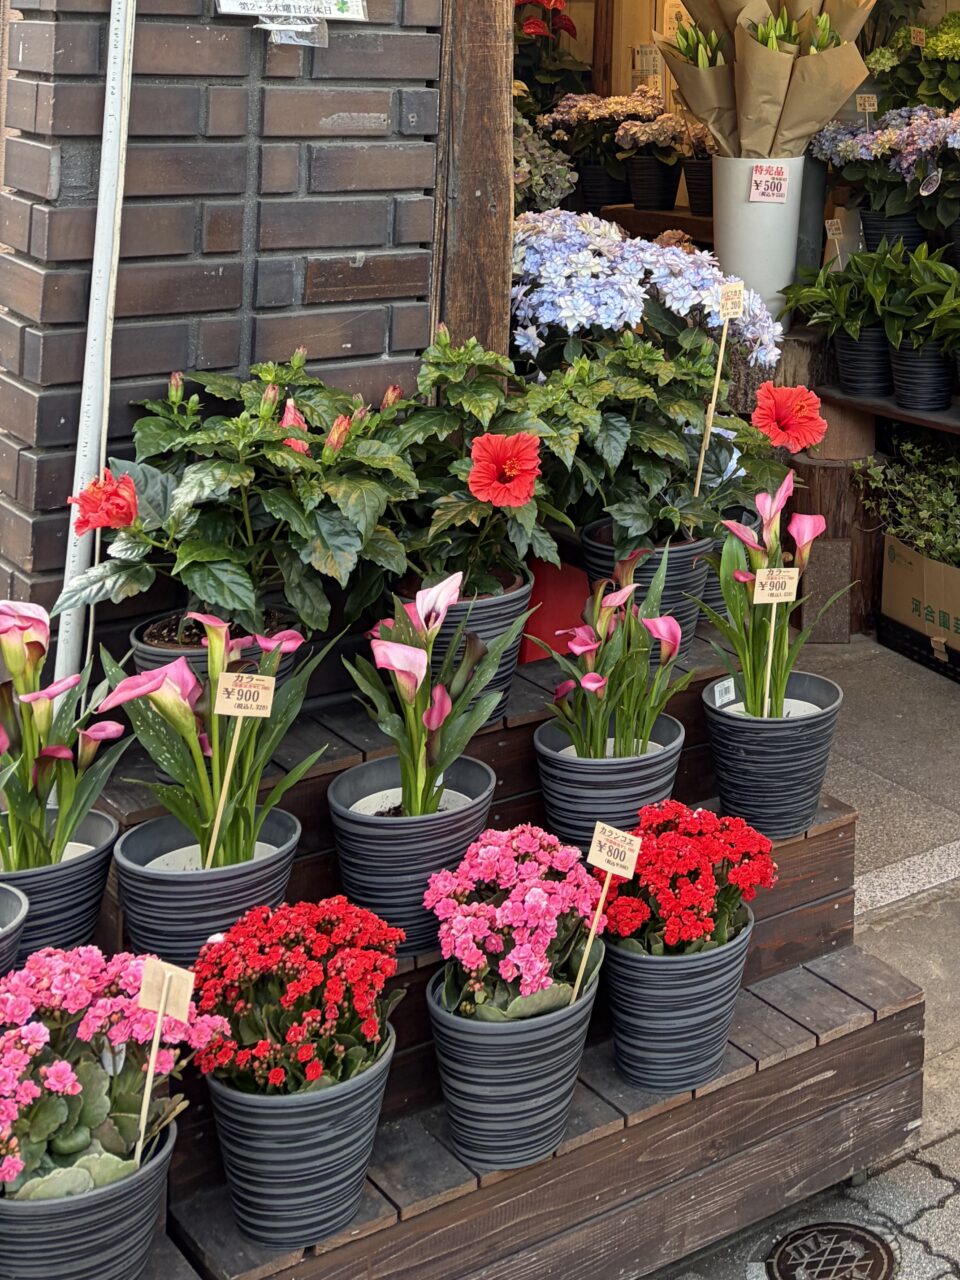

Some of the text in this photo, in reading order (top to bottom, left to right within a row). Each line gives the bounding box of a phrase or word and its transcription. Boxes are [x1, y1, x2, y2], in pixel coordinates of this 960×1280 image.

[752, 164, 784, 176] 特売品
[752, 180, 783, 192] ¥500
[758, 580, 787, 591] ¥900
[233, 674, 266, 683] カラー
[222, 687, 260, 703] ¥900
[599, 826, 635, 847] カランコエ
[596, 839, 627, 863] ¥800
